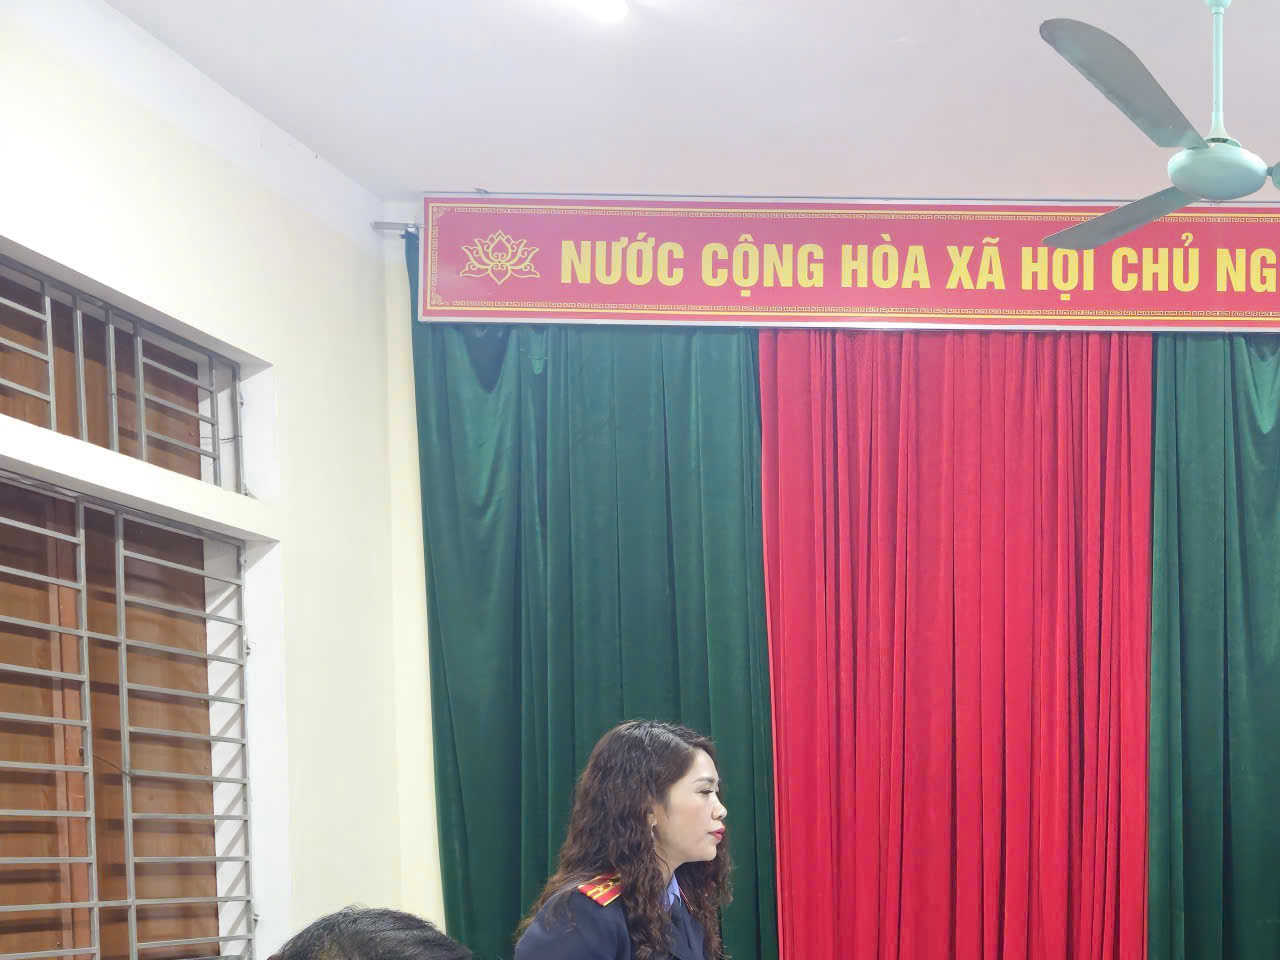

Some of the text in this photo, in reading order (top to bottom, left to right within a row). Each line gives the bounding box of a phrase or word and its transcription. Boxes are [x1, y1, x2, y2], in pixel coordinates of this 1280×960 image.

[560, 231, 686, 288] NƯỚC
[701, 231, 825, 299] CỘNG
[839, 233, 932, 290] HÒA
[945, 236, 1007, 291] XÃ
[1111, 231, 1200, 293] CHỦ
